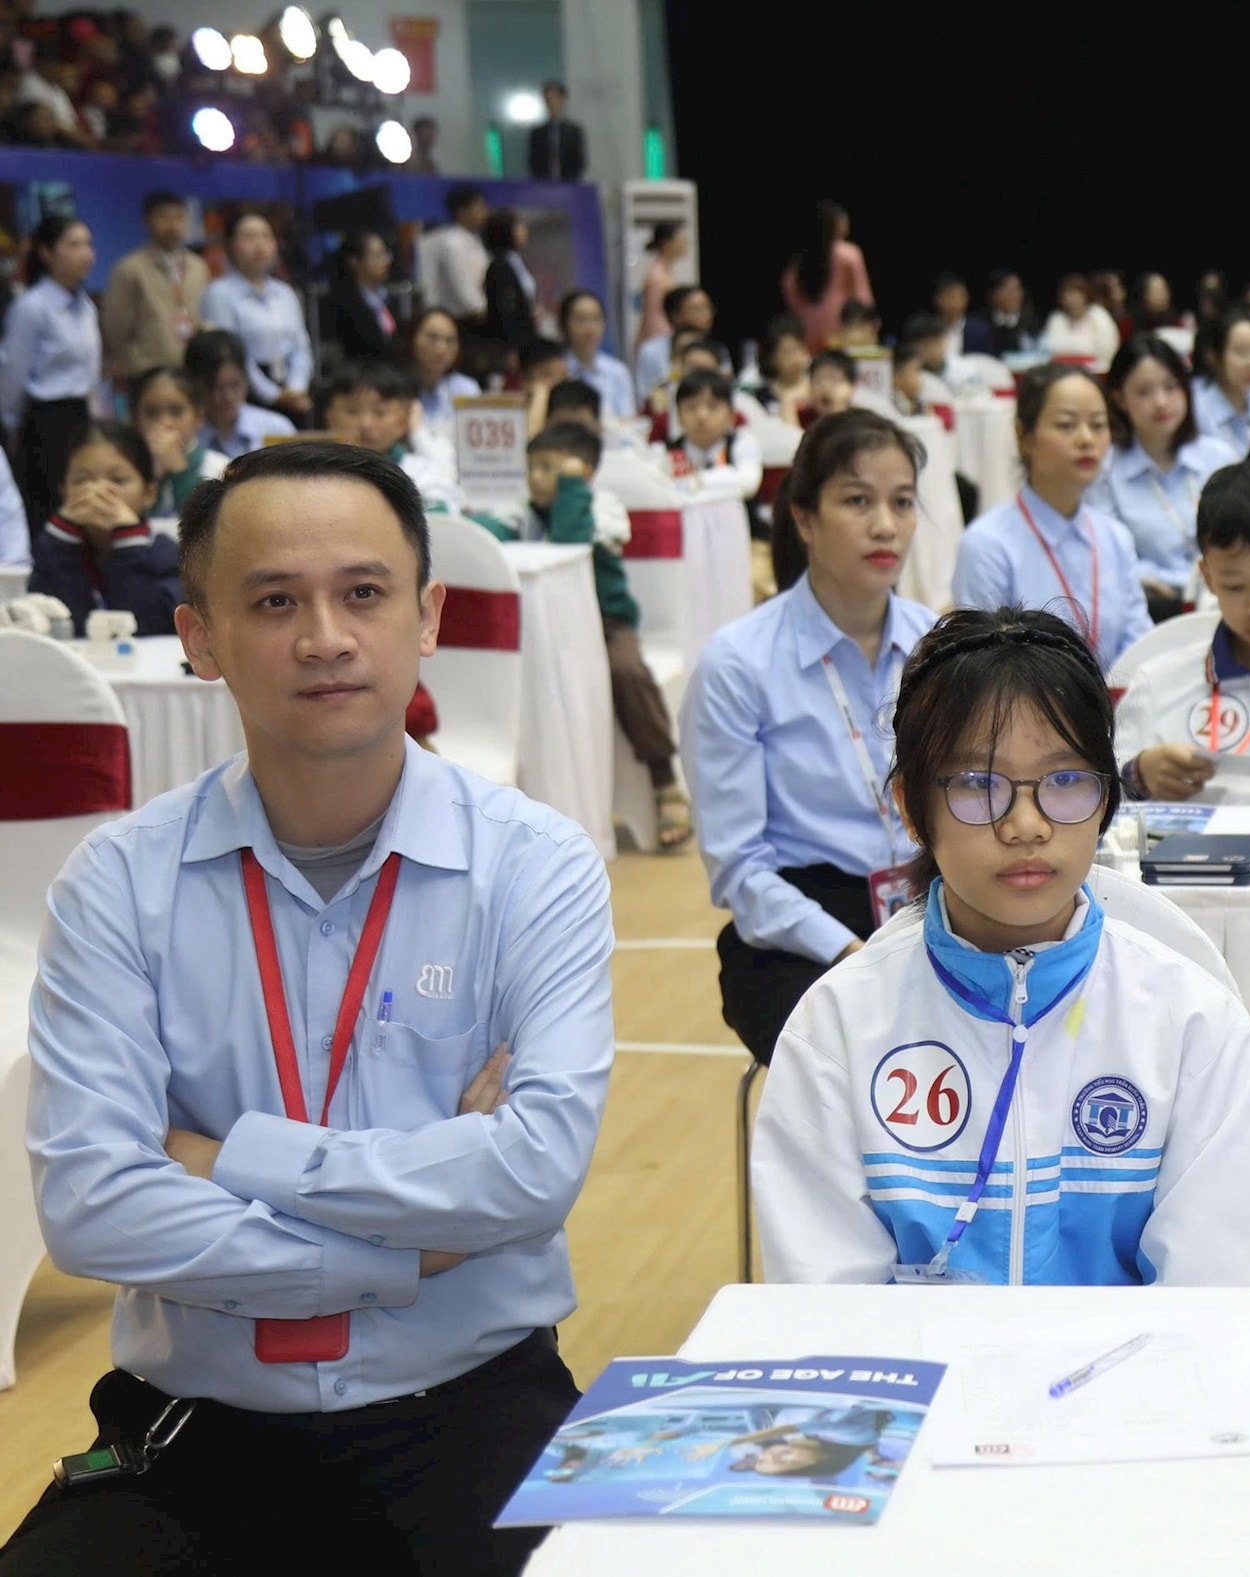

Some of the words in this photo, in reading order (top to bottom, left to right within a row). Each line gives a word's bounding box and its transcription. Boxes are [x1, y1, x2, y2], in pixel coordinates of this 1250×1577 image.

[886, 1064, 960, 1127] 26
[713, 1369, 763, 1381] OF
[770, 1368, 845, 1381] AGE
[849, 1369, 918, 1386] THE
